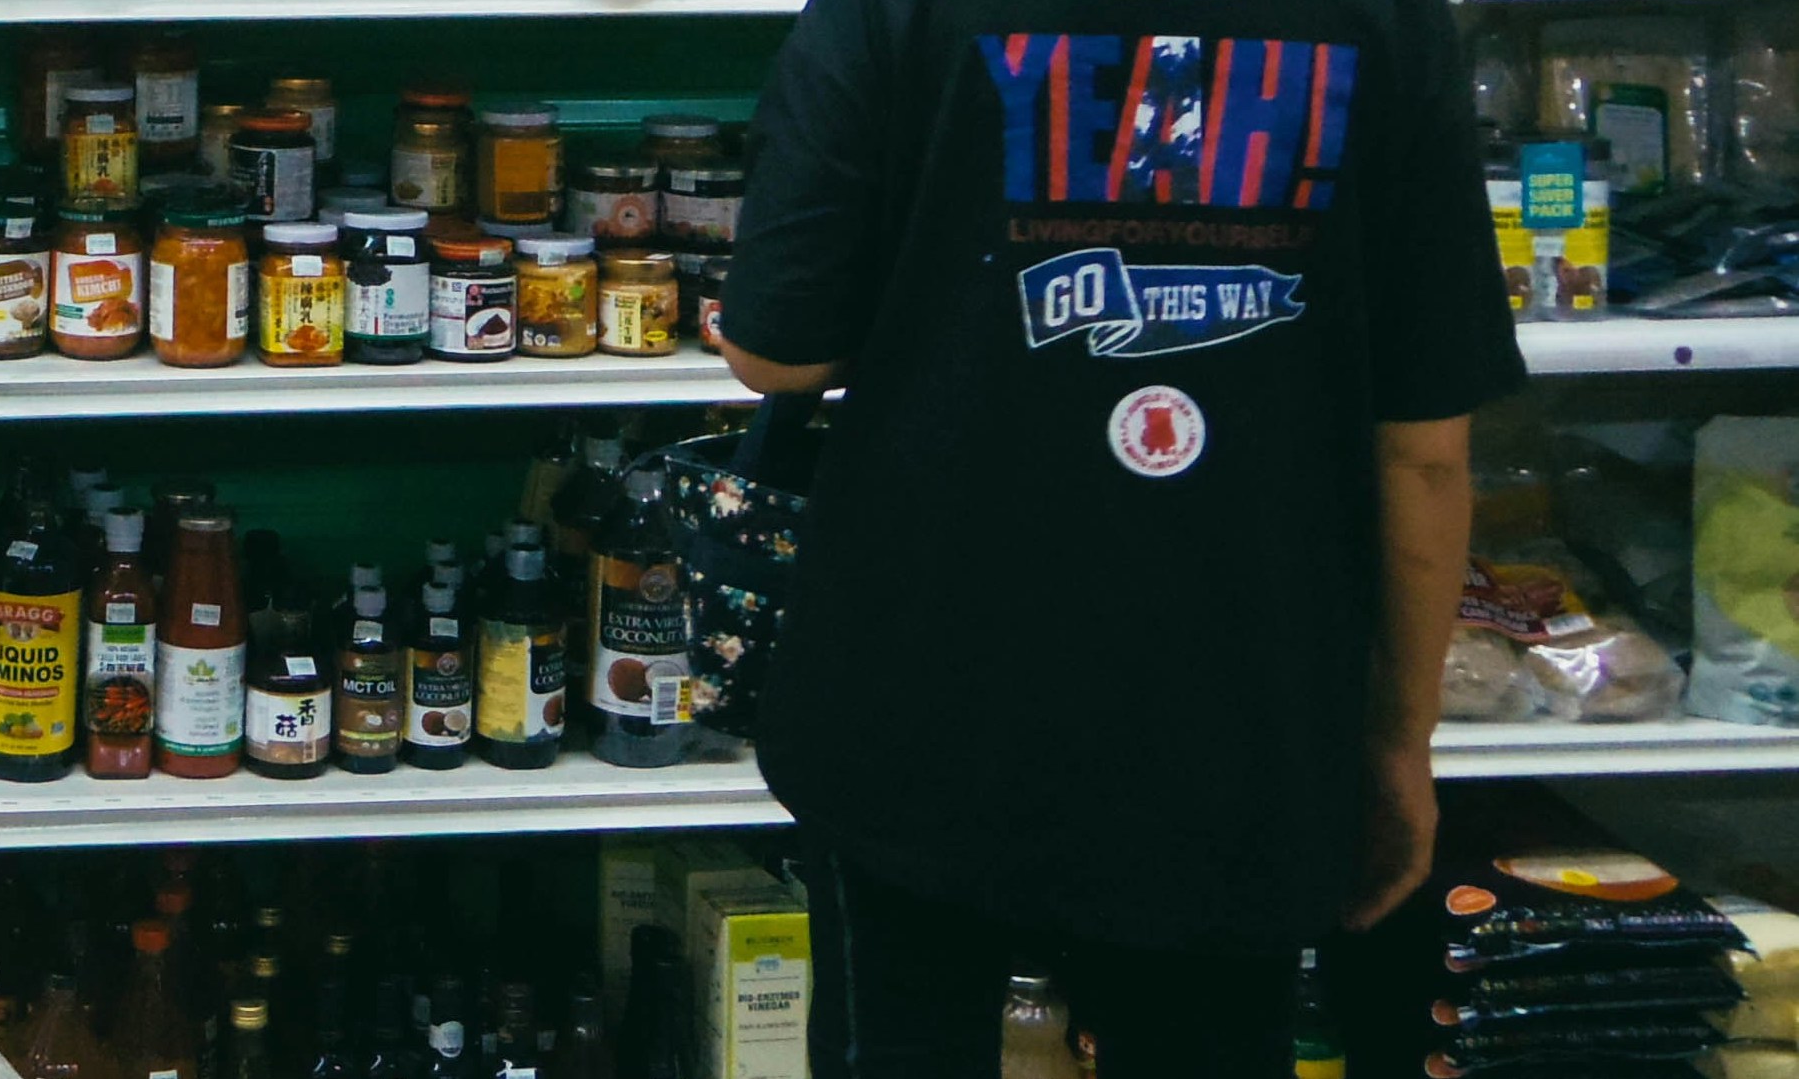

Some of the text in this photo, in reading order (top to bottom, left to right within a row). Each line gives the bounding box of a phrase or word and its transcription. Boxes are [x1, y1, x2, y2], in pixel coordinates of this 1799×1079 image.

[974, 32, 1359, 210] YEAH!
[76, 278, 122, 297] KIMCHI
[1043, 261, 1273, 328] GO THIS WAY
[608, 612, 650, 627] EXTRA
[343, 677, 397, 695] MCT OIL
